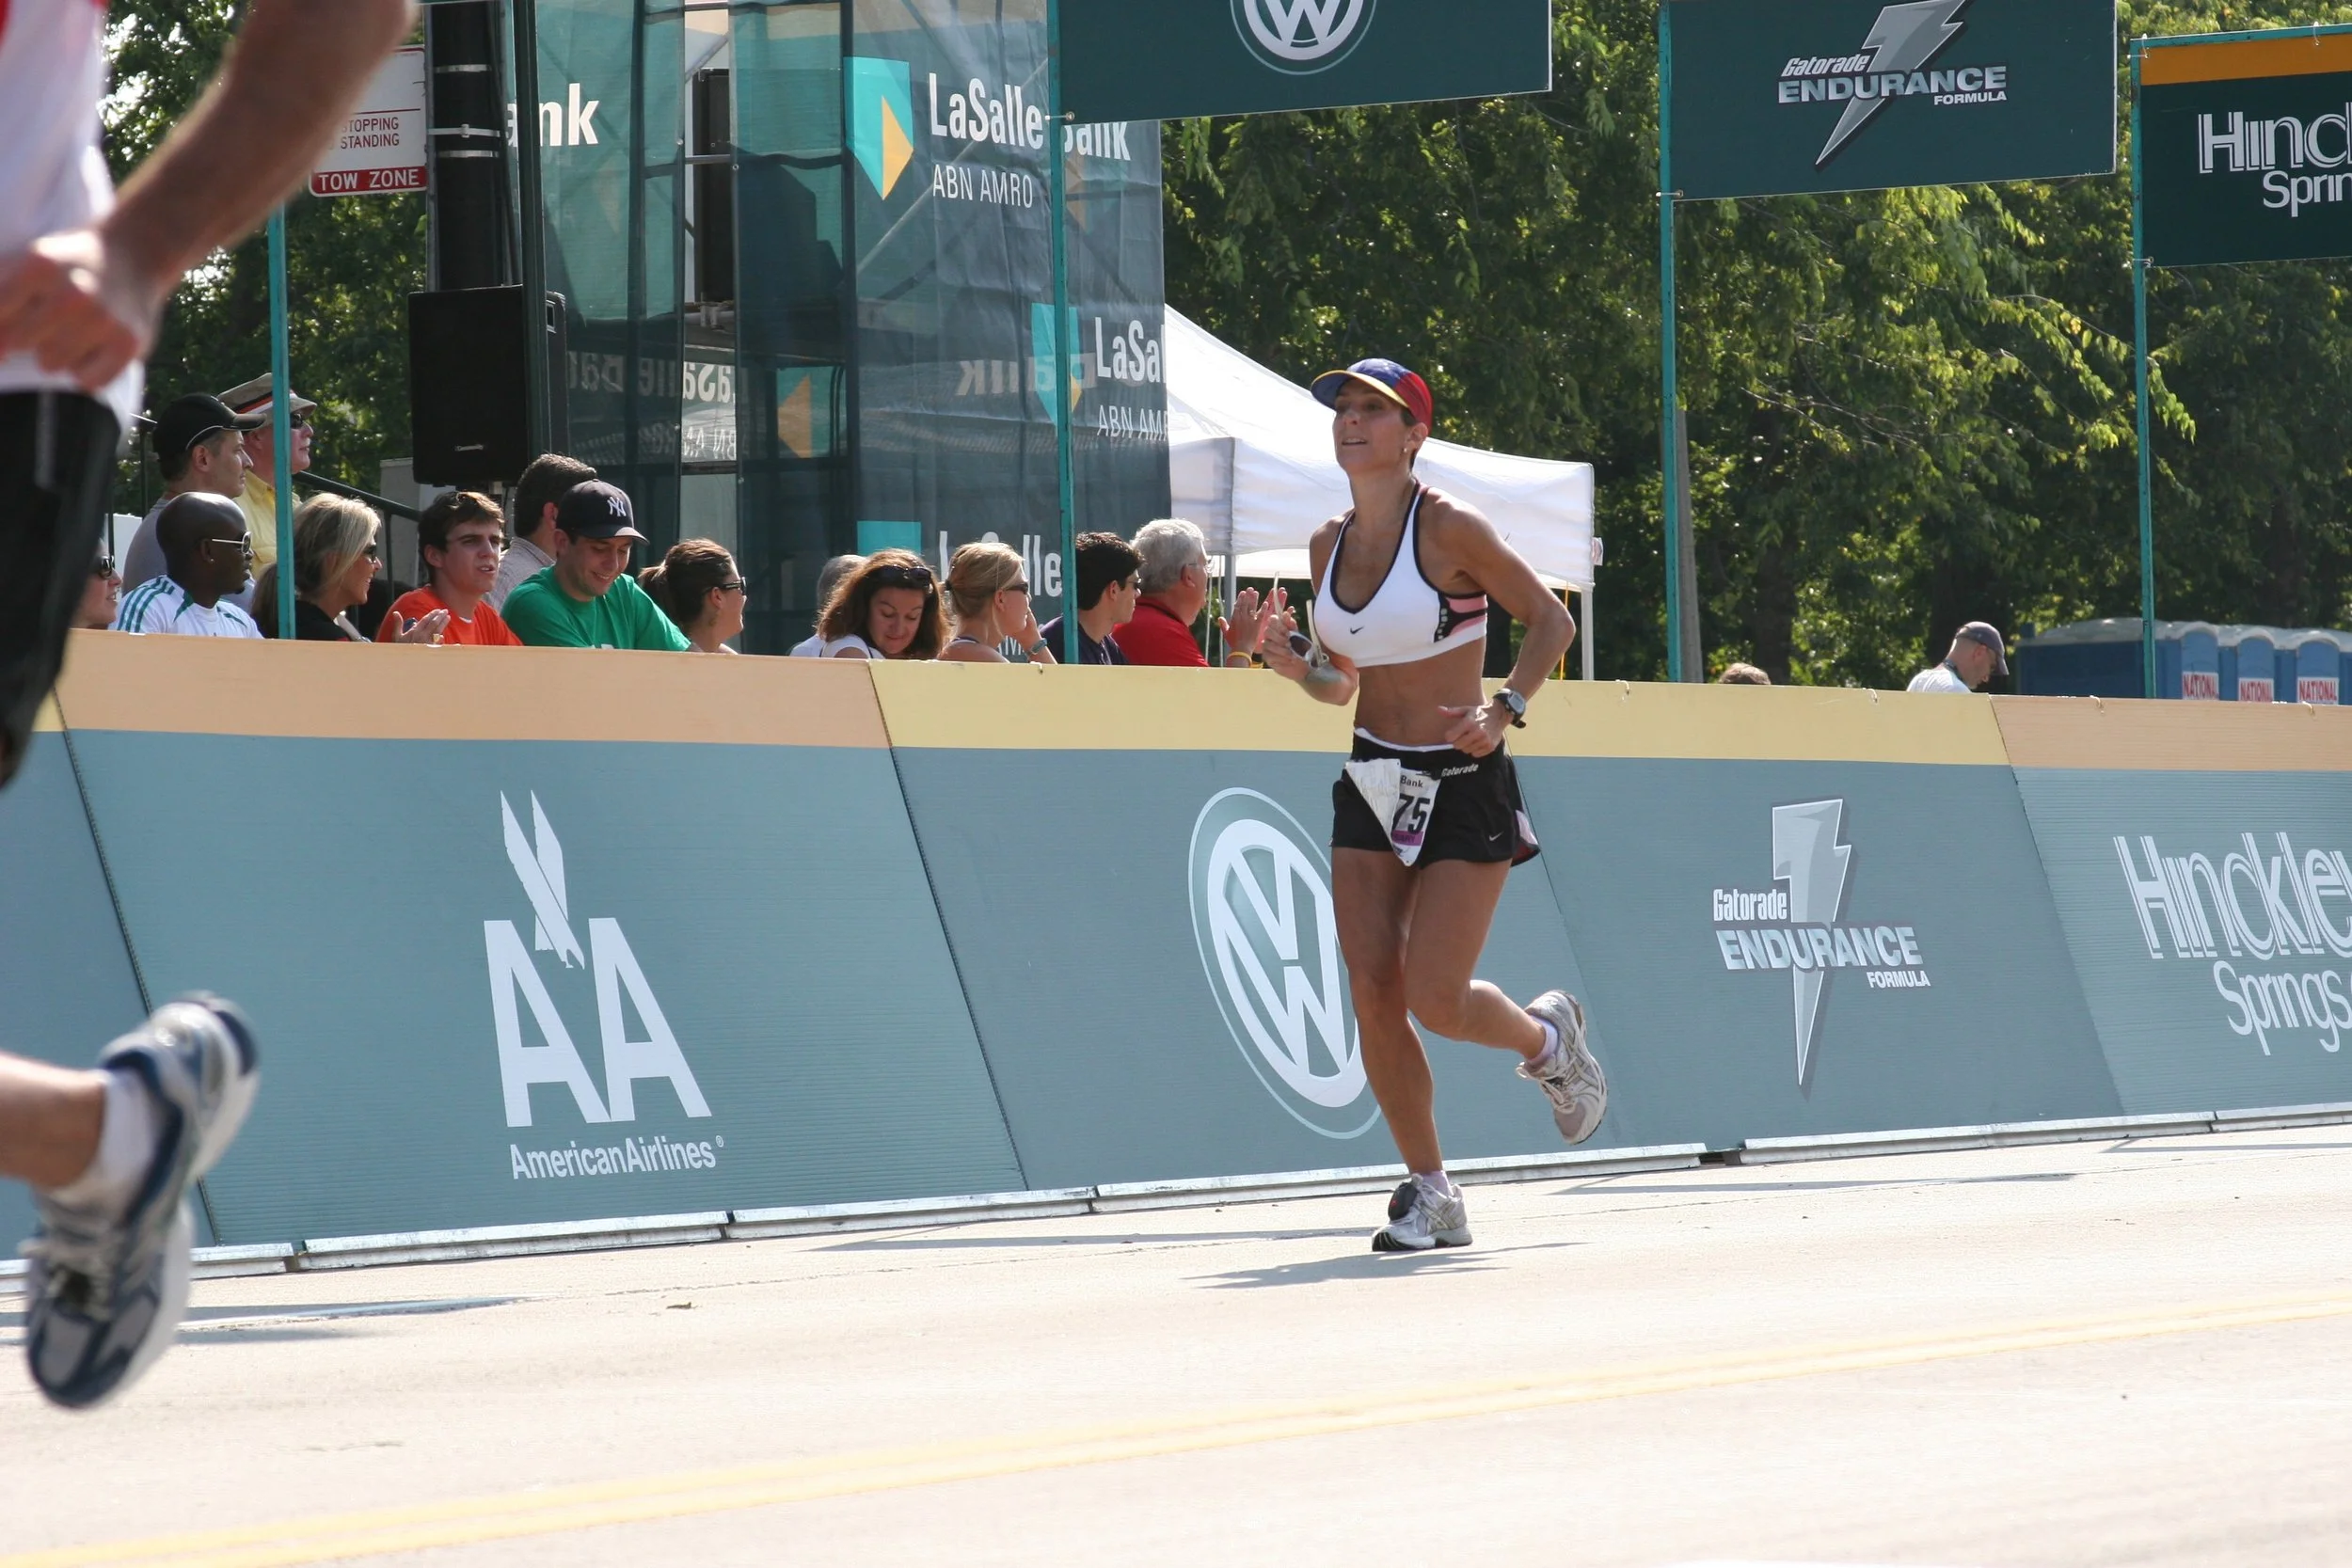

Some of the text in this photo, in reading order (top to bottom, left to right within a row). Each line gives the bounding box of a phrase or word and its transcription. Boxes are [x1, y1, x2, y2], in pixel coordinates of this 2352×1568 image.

[1781, 54, 1870, 77] Gatorade
[1777, 66, 2007, 104] ENDURANCE
[1934, 90, 2007, 105] FORMULA
[929, 72, 1044, 150] LaSalle
[341, 134, 400, 149] STANDING
[2198, 102, 2352, 174] Hinc
[318, 168, 420, 191] TOW ZONE
[933, 164, 1033, 209] ABN AMRO
[1097, 404, 1133, 439] ABN
[607, 496, 627, 517] NY
[2298, 680, 2337, 702] NATIONAL
[1400, 774, 1423, 788] Bank
[1713, 888, 1788, 922] Gatorade
[1715, 926, 1924, 971] ENDURANCE
[1866, 970, 1931, 989] FORMULA
[484, 917, 712, 1128] AA
[2213, 959, 2352, 1055] Springs
